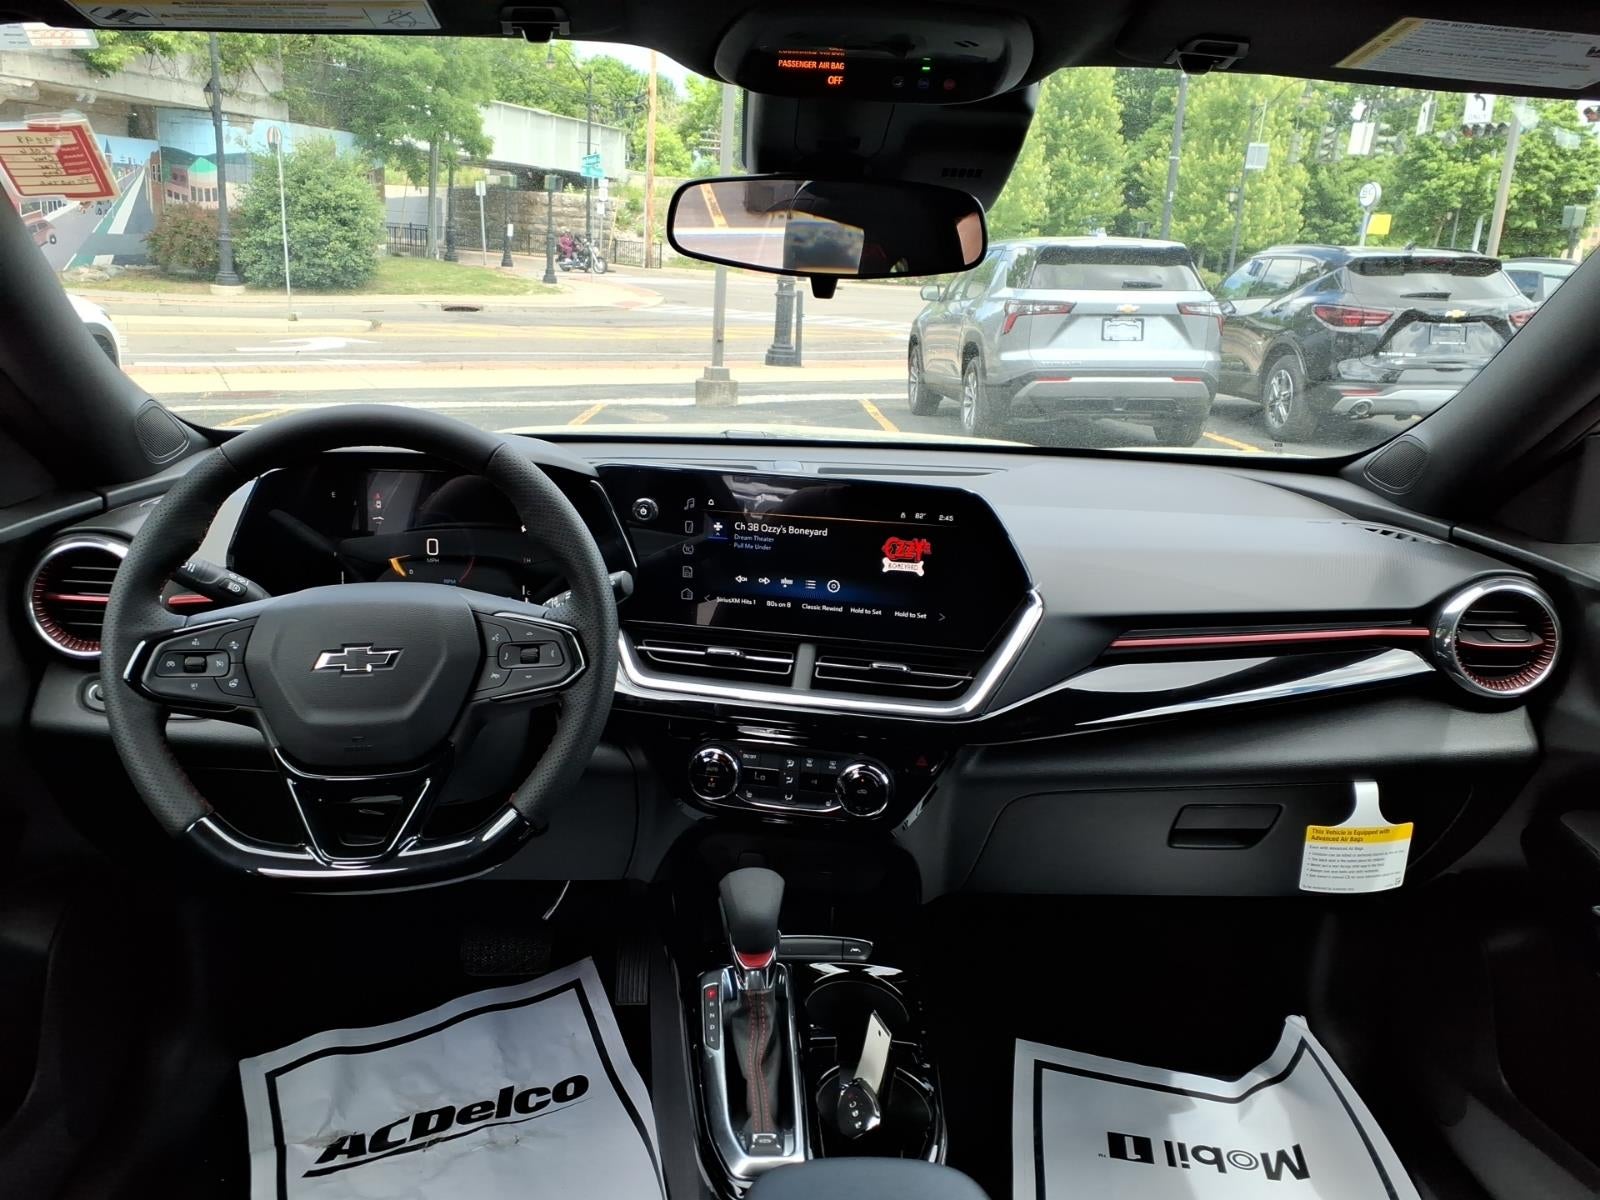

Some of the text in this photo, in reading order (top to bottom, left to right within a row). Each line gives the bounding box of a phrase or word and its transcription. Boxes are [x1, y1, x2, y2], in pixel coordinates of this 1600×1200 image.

[778, 59, 845, 70] PASSENGER AIR BAG
[828, 75, 844, 85] OFF
[734, 522, 745, 531] Ch
[761, 524, 787, 535] Ozzy's
[788, 526, 828, 537] Boneyard
[426, 538, 439, 555] 0
[716, 596, 740, 604] SiriusXM
[801, 603, 844, 612] Classic Rewind
[315, 1074, 589, 1164] ACDelco
[1164, 1143, 1310, 1181] Mobil
